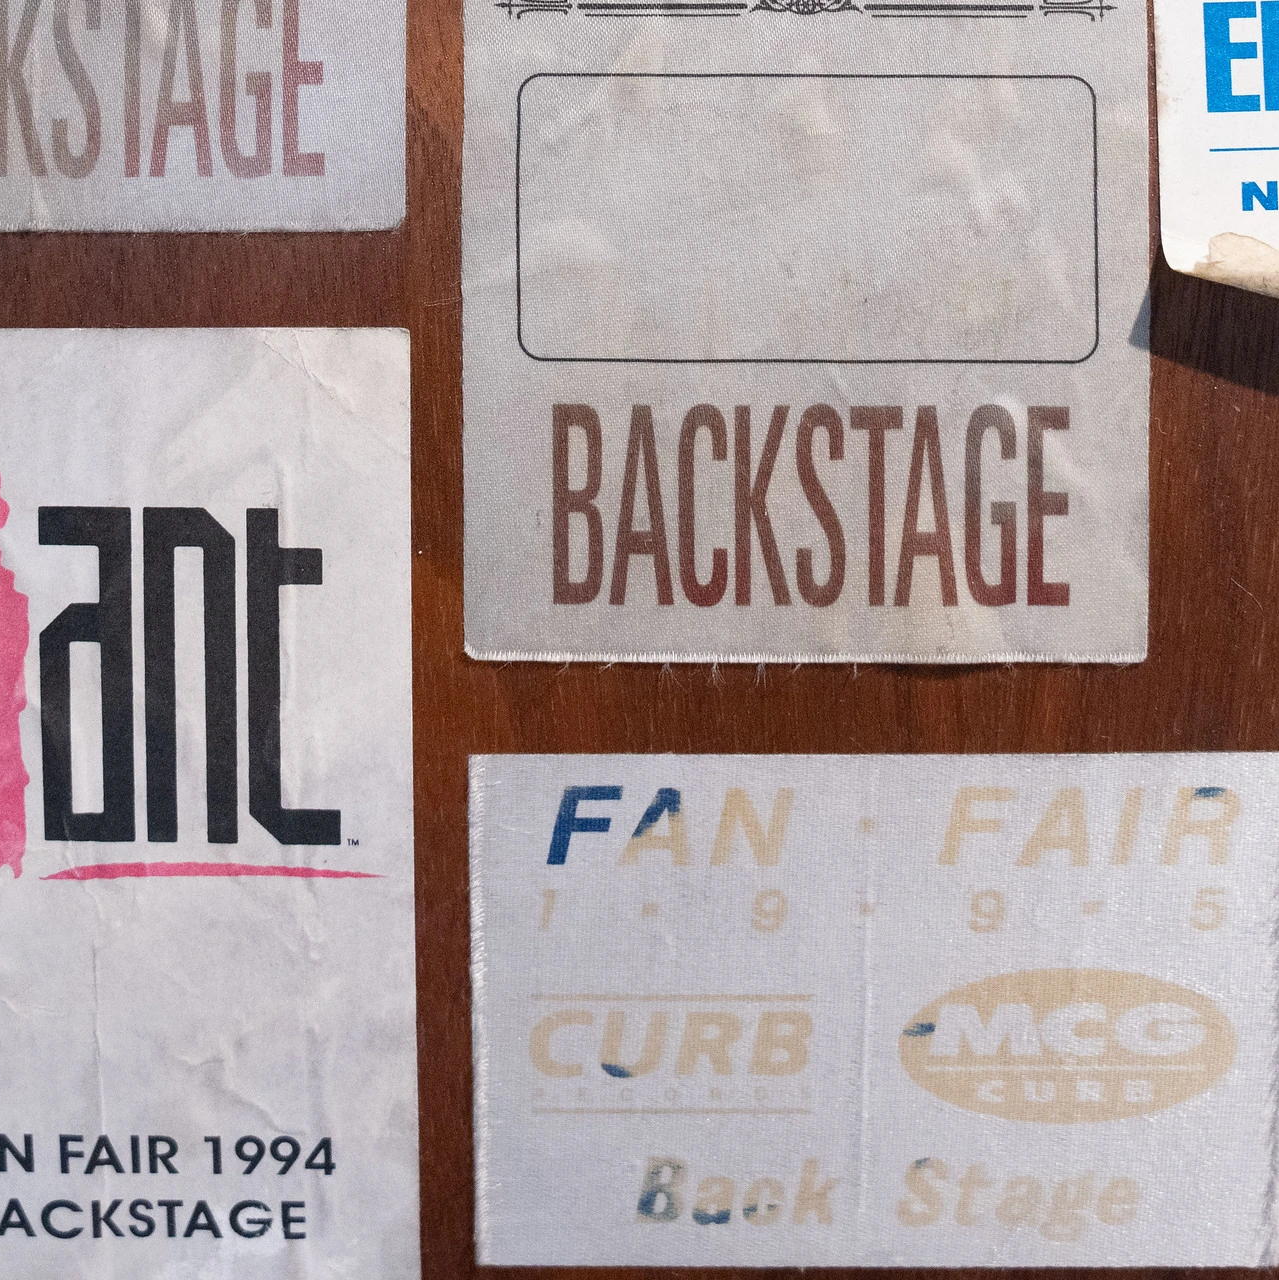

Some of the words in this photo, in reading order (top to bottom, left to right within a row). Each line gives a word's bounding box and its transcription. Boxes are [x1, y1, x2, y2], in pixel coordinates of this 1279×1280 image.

[550, 401, 1071, 609] BACKSTAGE
[546, 785, 794, 867] FAN
[937, 785, 1243, 867] FAIR
[528, 1009, 813, 1078] CURB
[929, 1002, 1206, 1056] MCG
[977, 1079, 1155, 1103] CURB
[58, 1133, 180, 1176] FAIR
[202, 1134, 337, 1177] 1994
[637, 1155, 841, 1227] Back
[897, 1156, 1141, 1243] Stage
